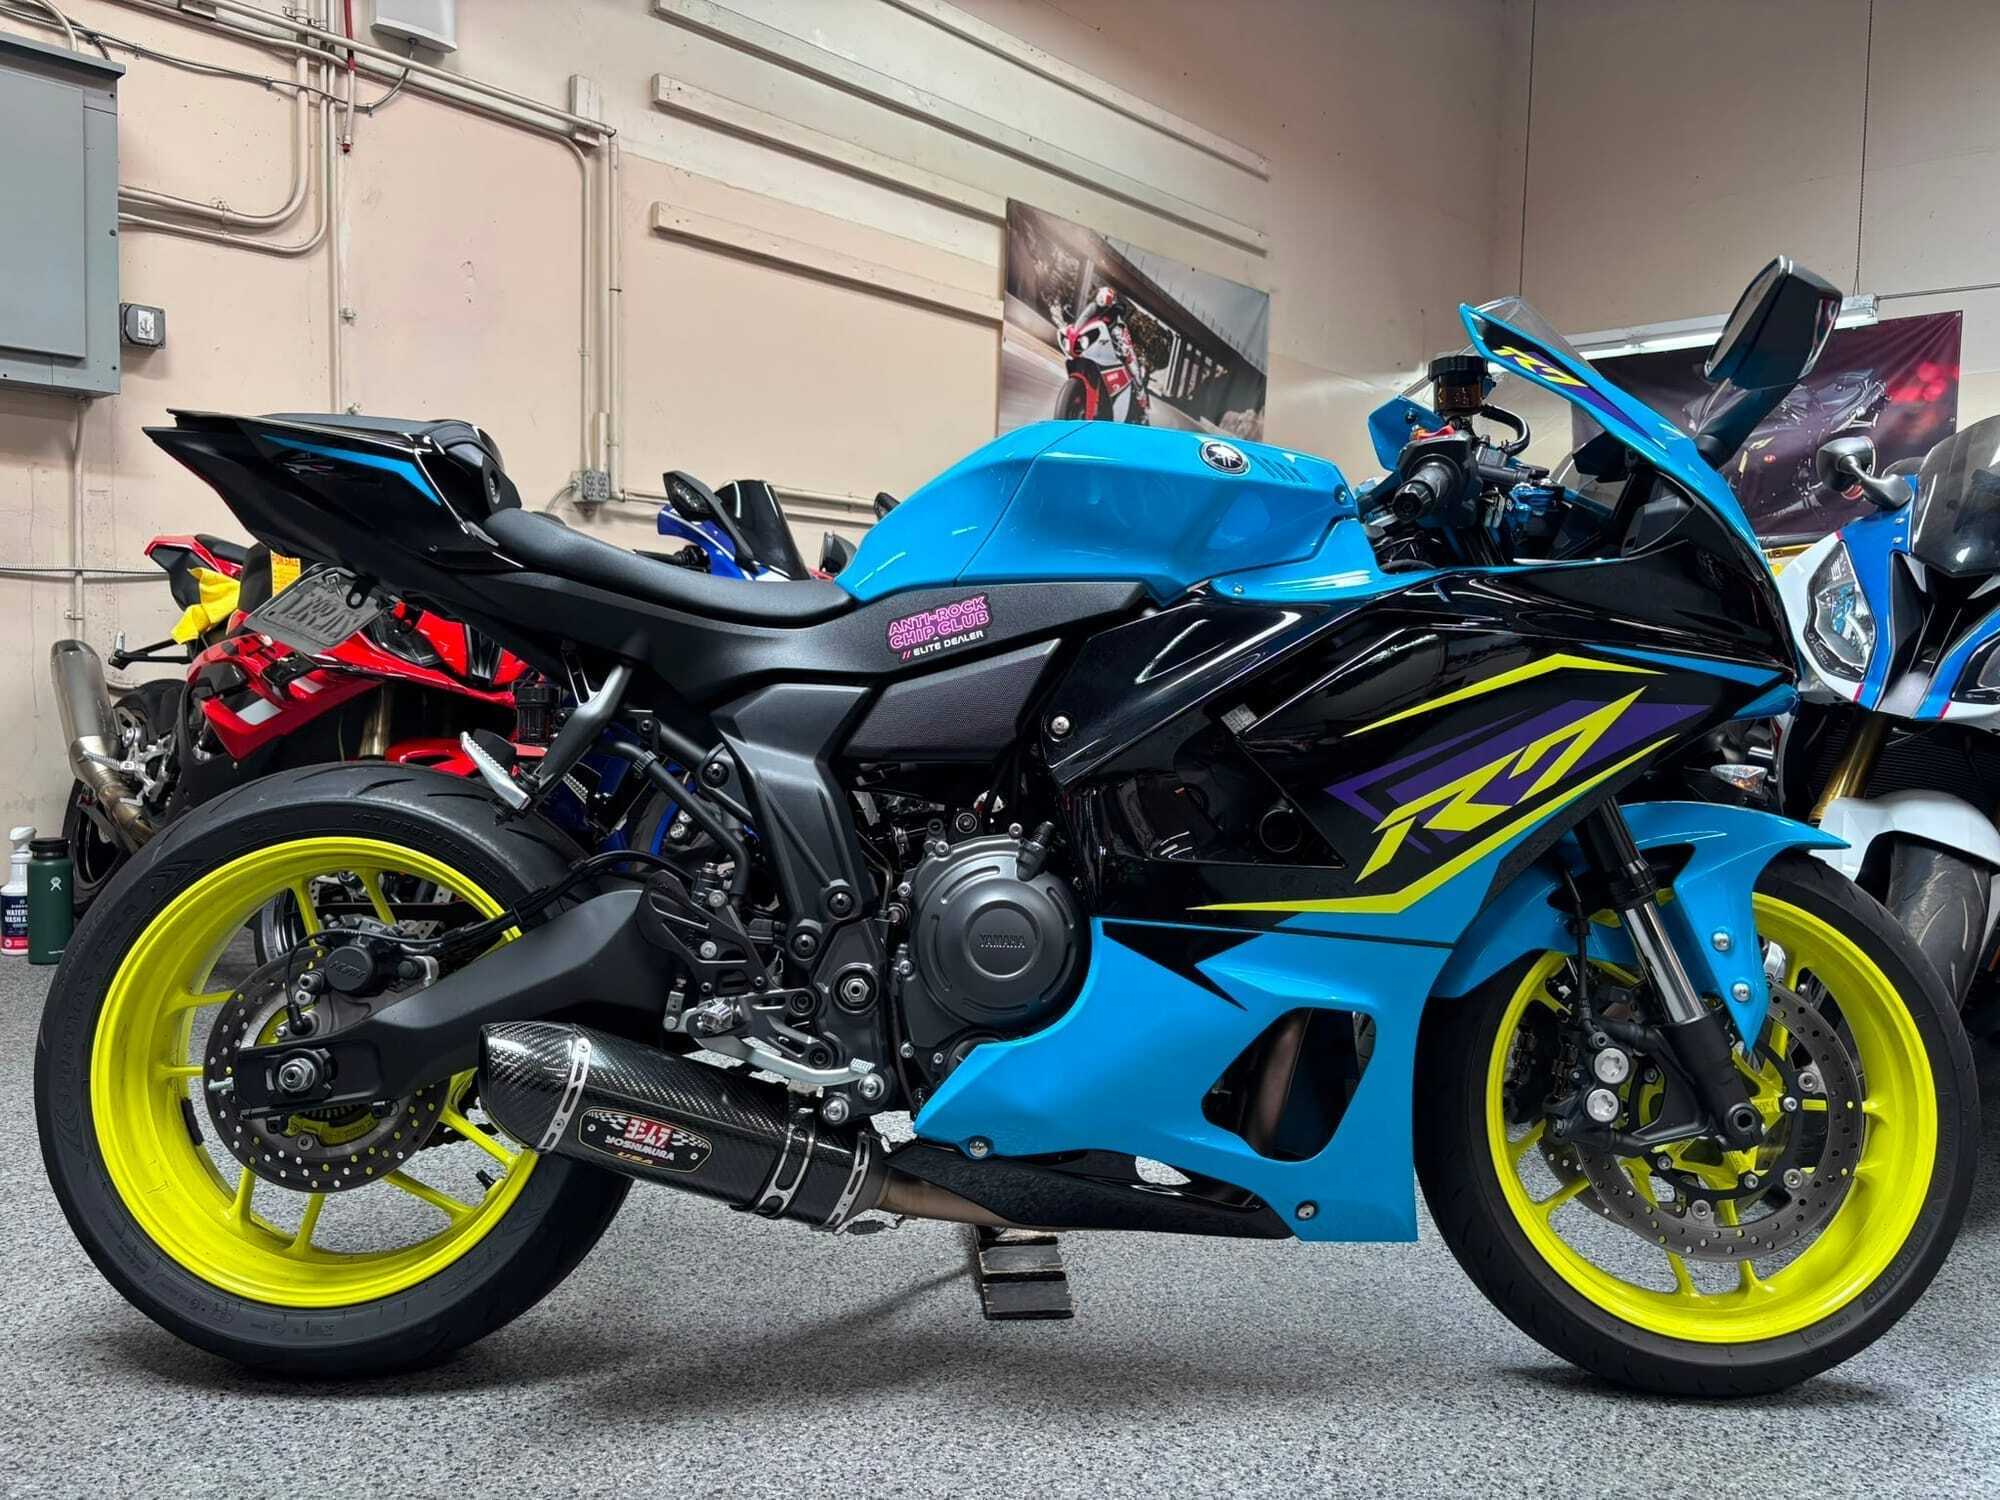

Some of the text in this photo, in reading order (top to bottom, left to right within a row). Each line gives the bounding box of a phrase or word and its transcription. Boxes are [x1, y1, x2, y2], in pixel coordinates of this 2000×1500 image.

[1493, 345, 1588, 388] R7
[889, 596, 986, 636] ANTI-ROCK
[890, 610, 990, 649] CHIP CLUB
[913, 640, 942, 656] ELITE
[943, 630, 985, 648] DEALER
[1354, 685, 1648, 885] R7
[604, 1134, 675, 1161] YOSHIMURA
